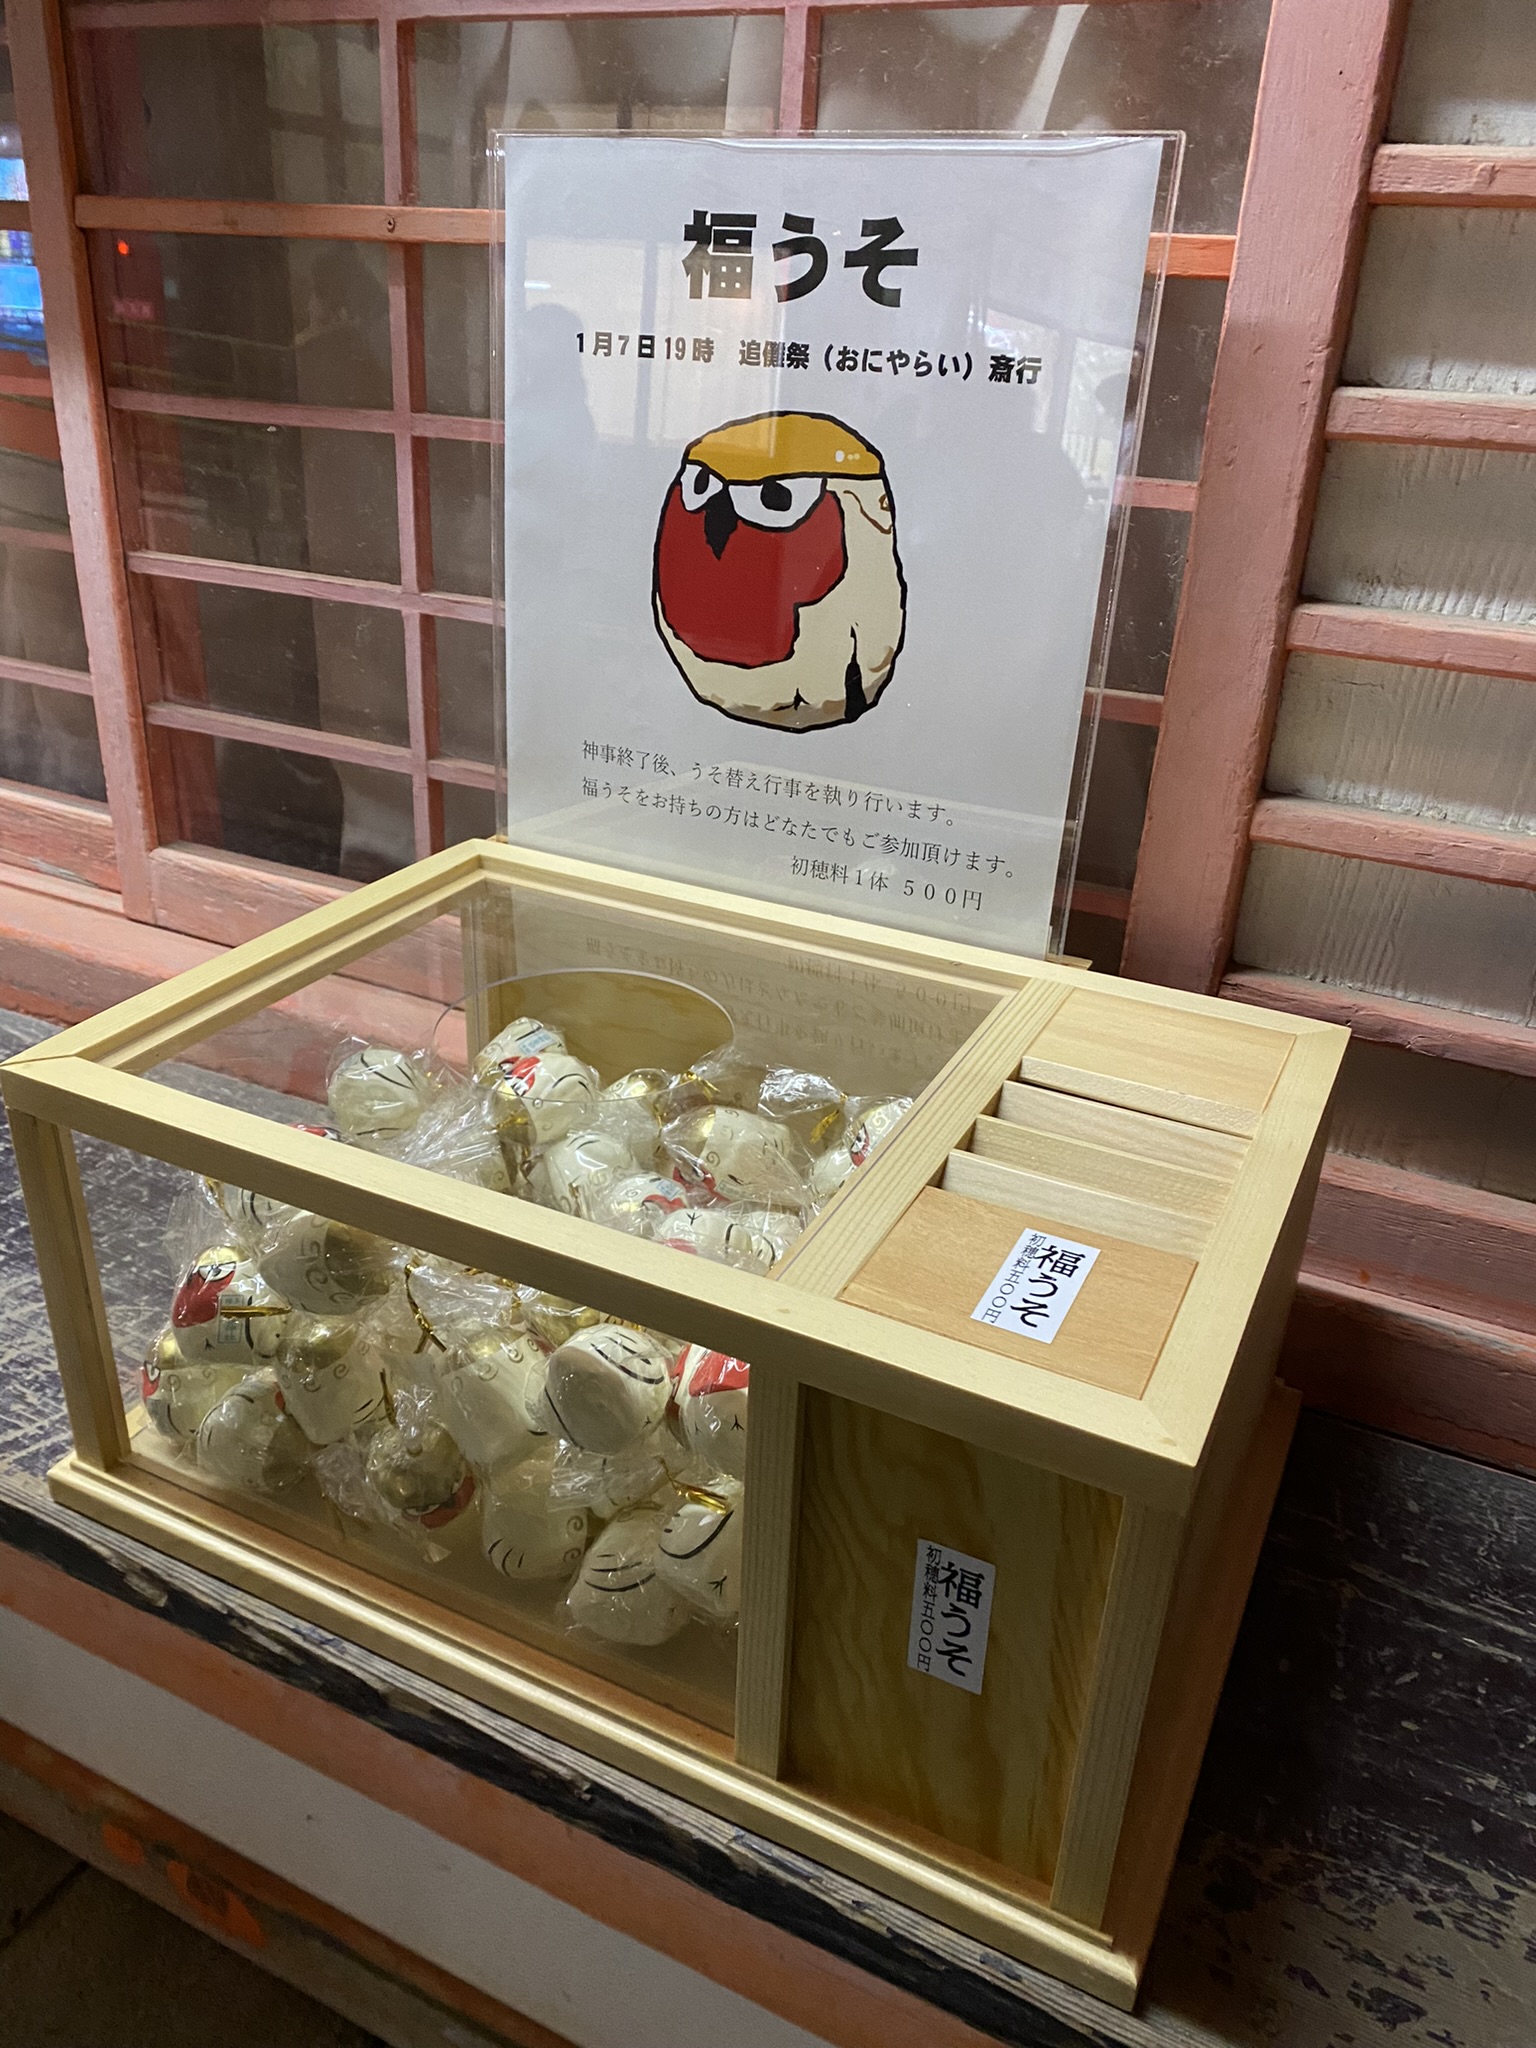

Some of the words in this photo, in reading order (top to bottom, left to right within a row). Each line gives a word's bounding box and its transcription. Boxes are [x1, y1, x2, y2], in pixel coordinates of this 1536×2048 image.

[682, 209, 919, 308] 福うそ
[581, 739, 954, 828] 神事終了後、うそ替え行事を執り行います。
[581, 776, 1014, 879] 福うそをお持ちの方はどなたでもご参加頂けます。
[1010, 1244, 1086, 1328] 福うそ
[935, 1561, 985, 1677] 福うそ
